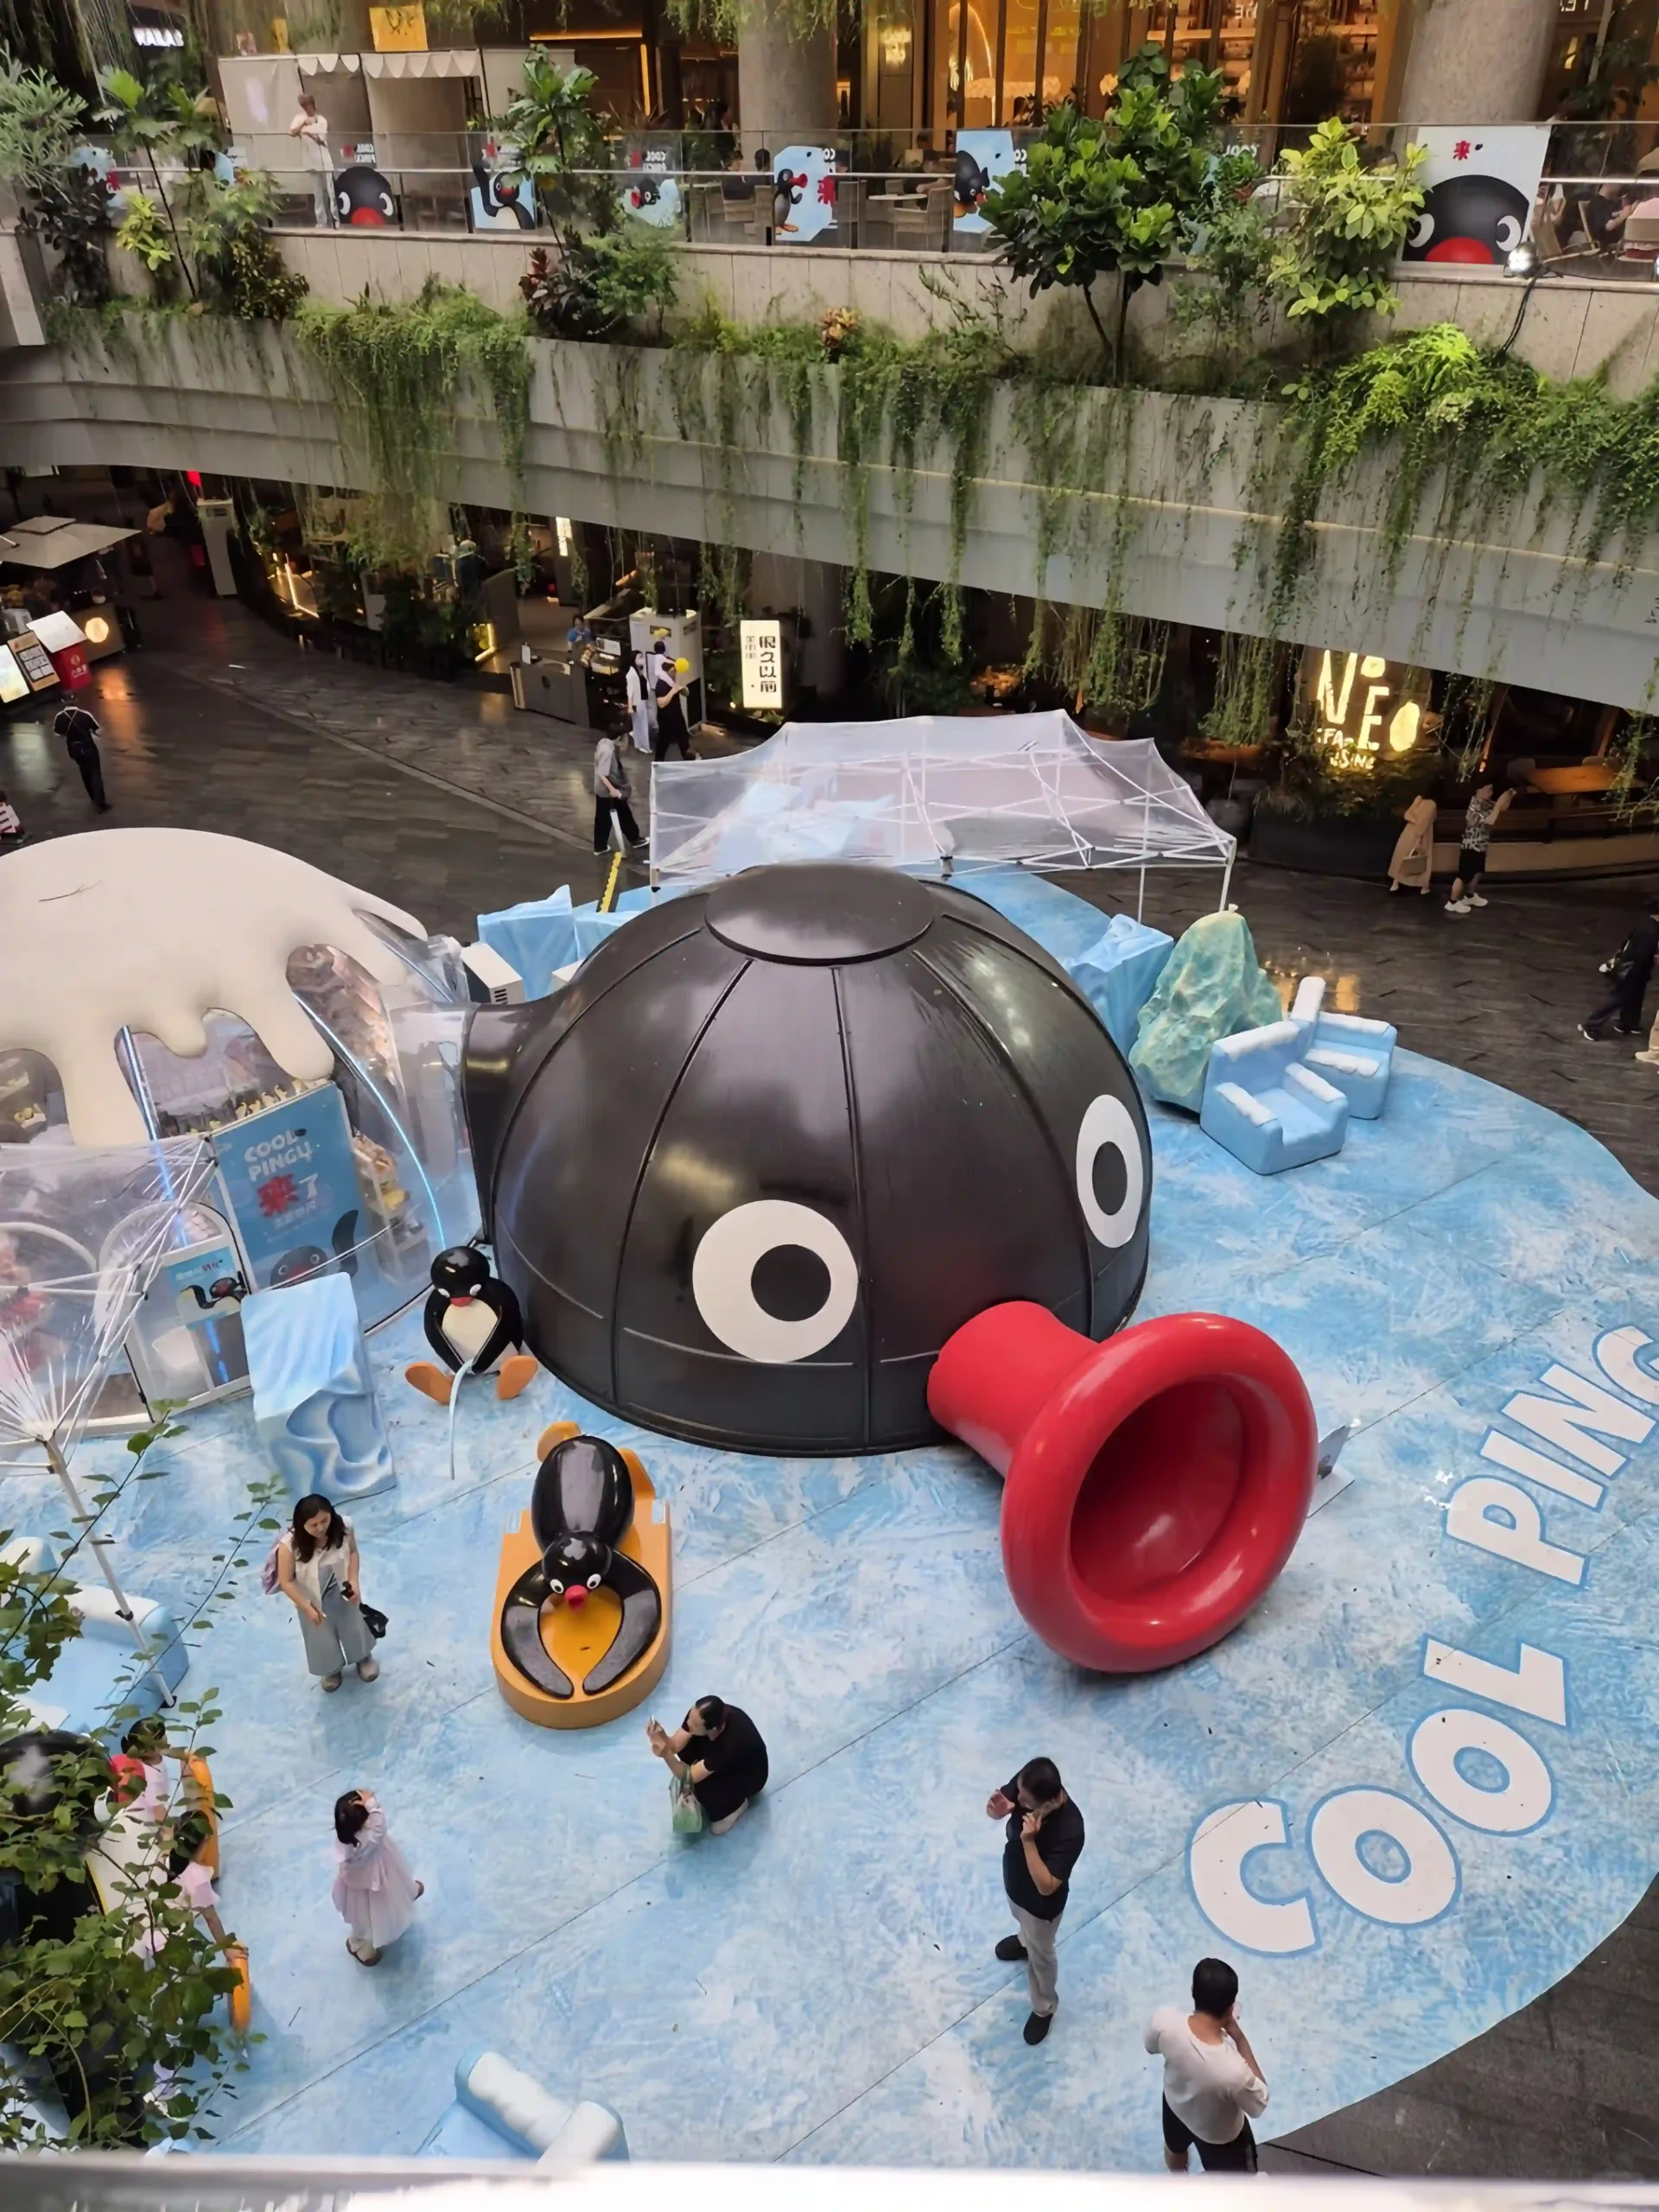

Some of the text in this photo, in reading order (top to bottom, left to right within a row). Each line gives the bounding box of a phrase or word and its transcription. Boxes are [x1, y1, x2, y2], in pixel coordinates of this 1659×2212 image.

[759, 635, 777, 693] 很久以前
[244, 1128, 298, 1163] COOL
[1187, 1637, 1570, 1955] COOL
